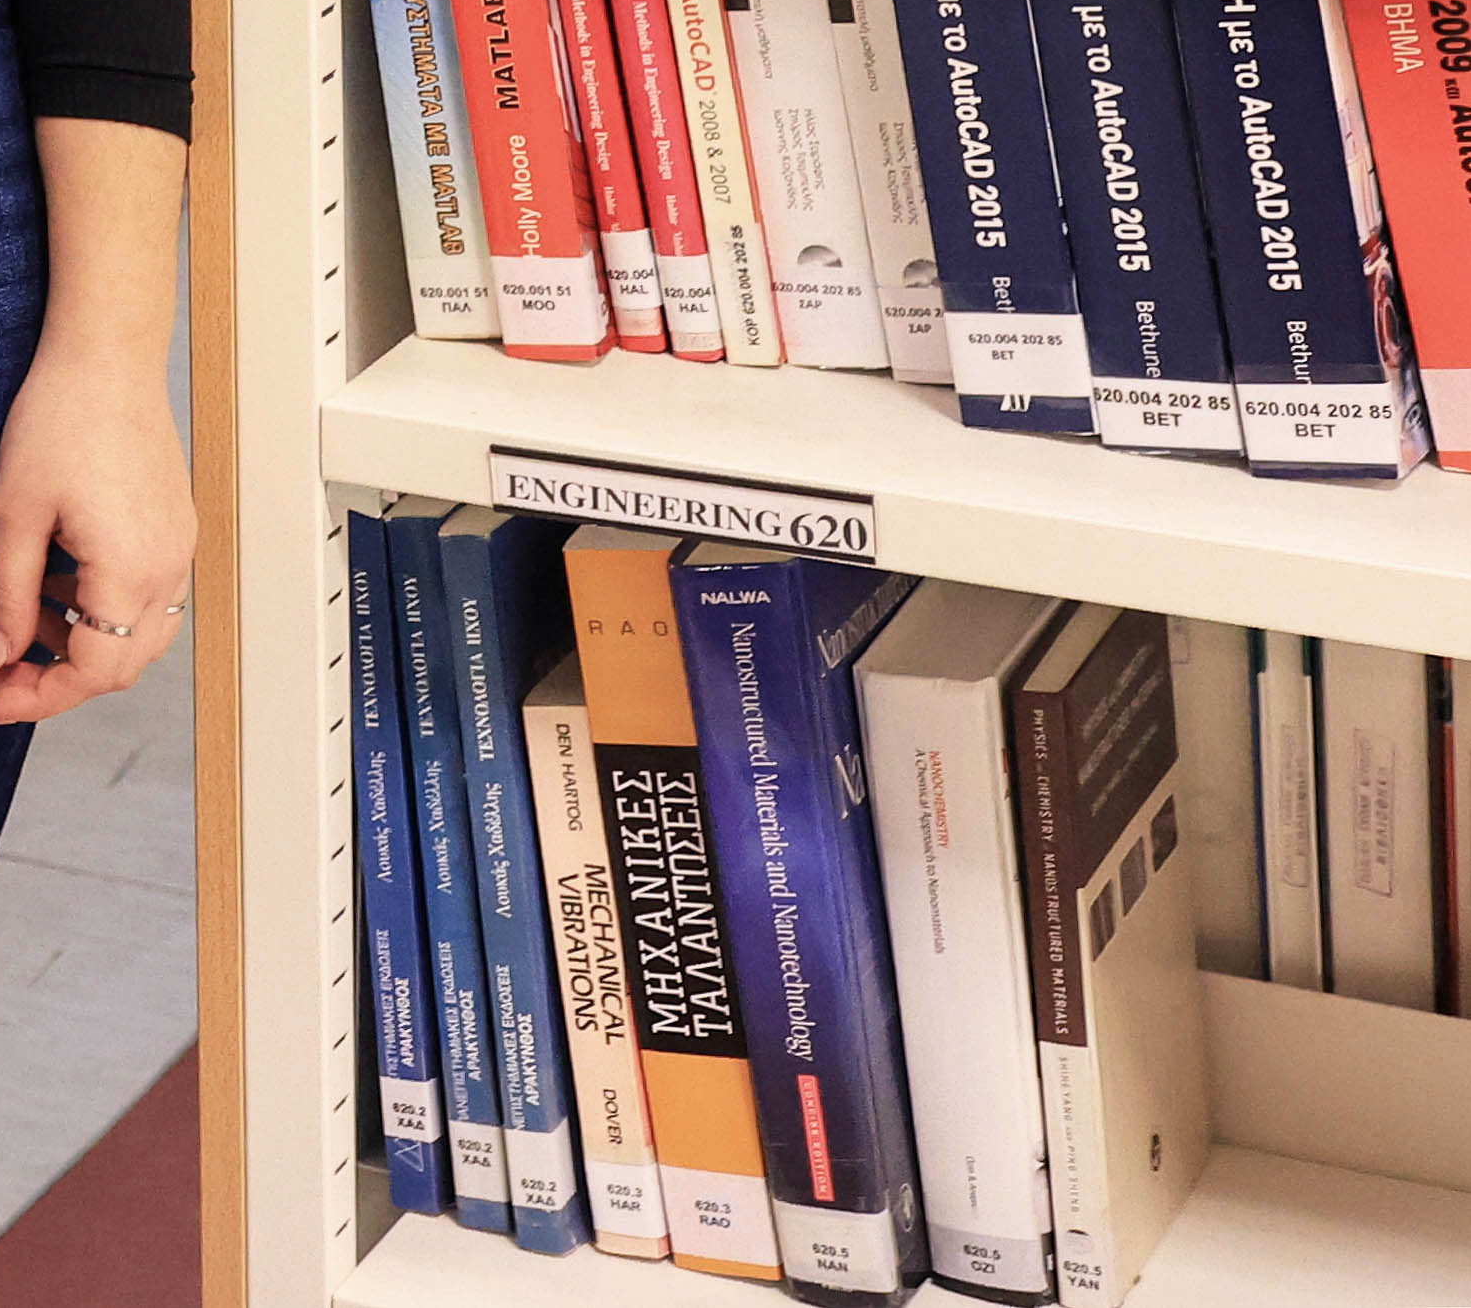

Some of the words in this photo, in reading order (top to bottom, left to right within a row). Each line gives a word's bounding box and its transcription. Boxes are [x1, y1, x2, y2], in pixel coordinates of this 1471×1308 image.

[943, 23, 967, 52] το
[1071, 4, 1106, 39] με
[1219, 19, 1255, 54] με
[1383, 2, 1425, 74] ΒΗΜΑ
[1428, 0, 1471, 74] 2009
[1087, 42, 1111, 73] το
[1234, 58, 1260, 89] το
[581, 60, 602, 128] Engineering
[593, 131, 611, 171] Design
[946, 57, 994, 179] AutoCAD
[1091, 77, 1139, 201] AutoCAD
[509, 135, 532, 202] Moore
[1239, 96, 1291, 220] AutoCAD
[520, 205, 541, 258] Holly
[968, 184, 1006, 248] 2015
[1111, 207, 1152, 272] 2015
[1260, 226, 1302, 292] 2015
[522, 299, 555, 311] MOO
[991, 350, 1015, 360] BET
[1143, 411, 1182, 427] BET
[1245, 401, 1321, 417] 620.004
[1327, 402, 1364, 418] 202
[1369, 403, 1392, 419] 85
[1295, 423, 1336, 438] BET
[507, 473, 782, 538] ENGINEERING
[790, 513, 868, 553] 620
[701, 591, 771, 605] NALWA
[731, 622, 778, 766] Nanostructured
[752, 771, 789, 857] Materials
[612, 771, 690, 1037] ΜΗΧΑΝΙΚΕΣ
[657, 772, 734, 1038] ΤΑΛΑΝΤΩΣΕΙΣ
[766, 859, 789, 897] and
[557, 874, 599, 1032] VIBRATIONS
[584, 864, 625, 1045] MECHANICAL
[771, 902, 817, 1062] Nanotechnology
[1051, 968, 1069, 1035] MATERIALS
[603, 1089, 622, 1145] DOVER
